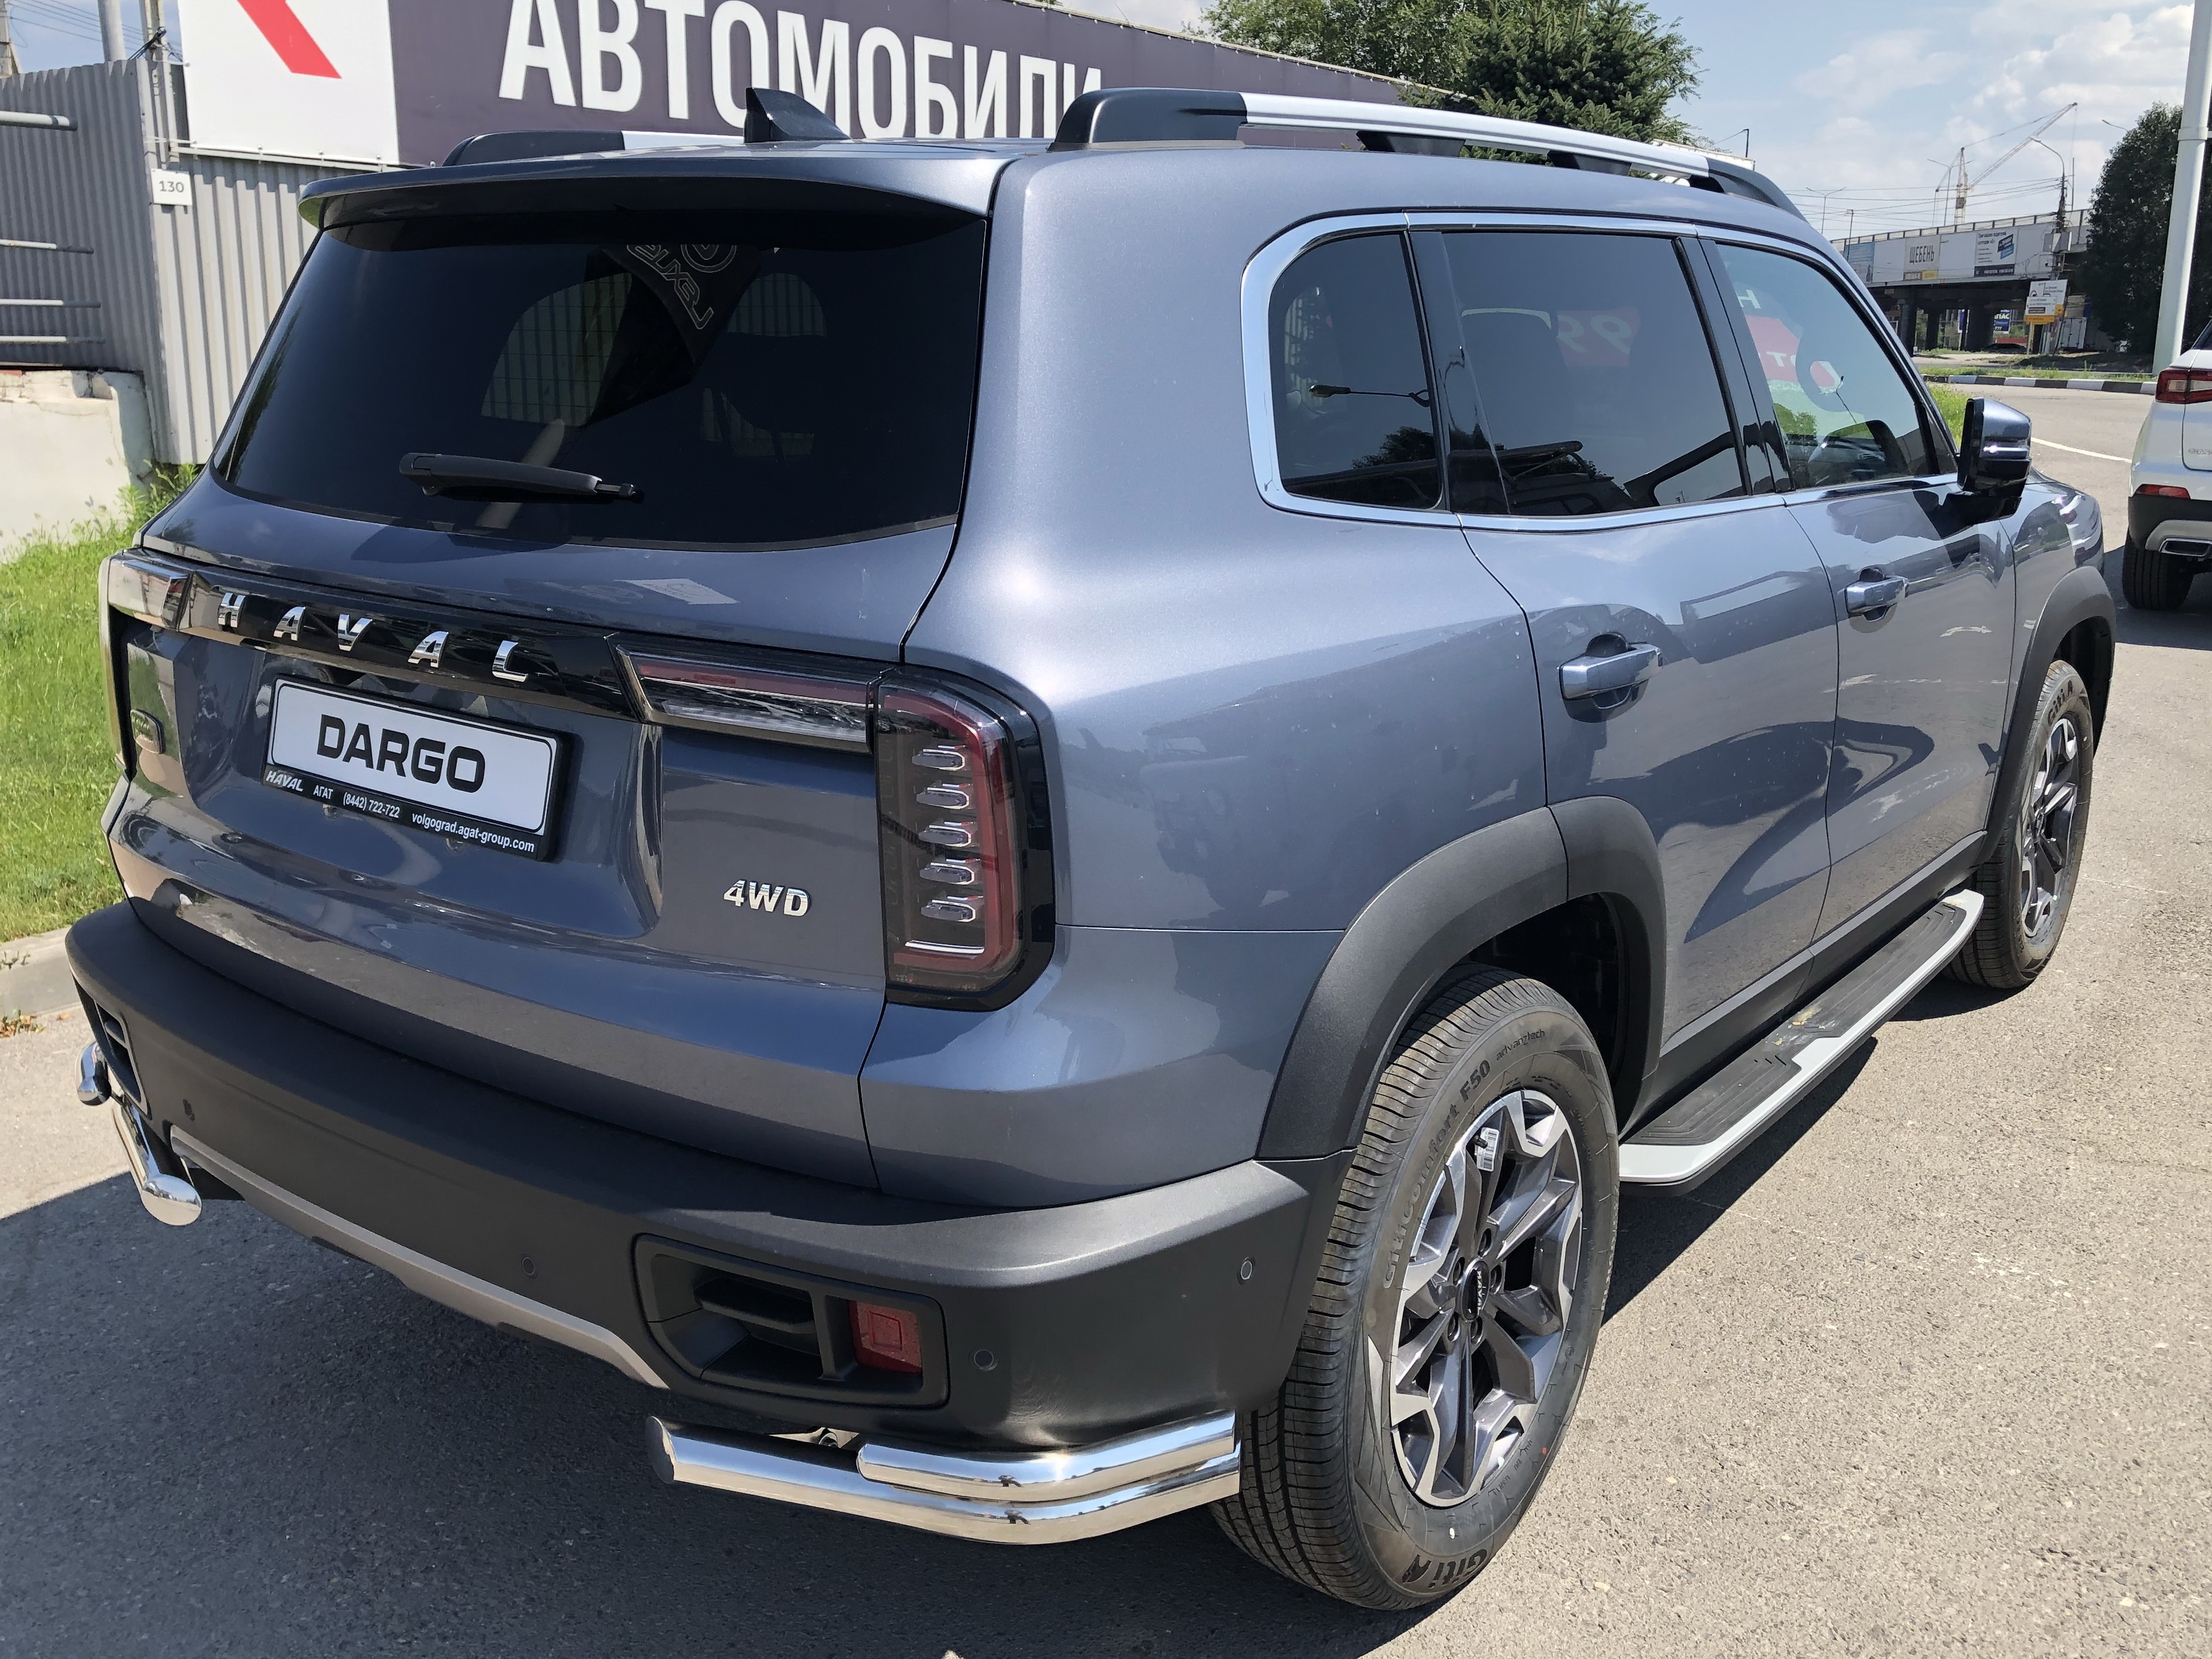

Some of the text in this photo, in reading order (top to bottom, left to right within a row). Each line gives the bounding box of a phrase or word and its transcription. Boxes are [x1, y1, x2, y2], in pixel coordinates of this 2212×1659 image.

[159, 181, 184, 193] 130
[1910, 245, 1934, 265] ЩЕБЕНЬ
[218, 592, 529, 683] HAVAL
[2048, 688, 2065, 726] Giti
[316, 713, 486, 793] DARGO
[266, 770, 535, 853] HAVAL АГАТ (8442) 722-722 volgograd.agat-group.com
[723, 880, 810, 916] 4WD
[1459, 1059, 1491, 1103] F50
[1428, 1549, 1488, 1589] Giti
